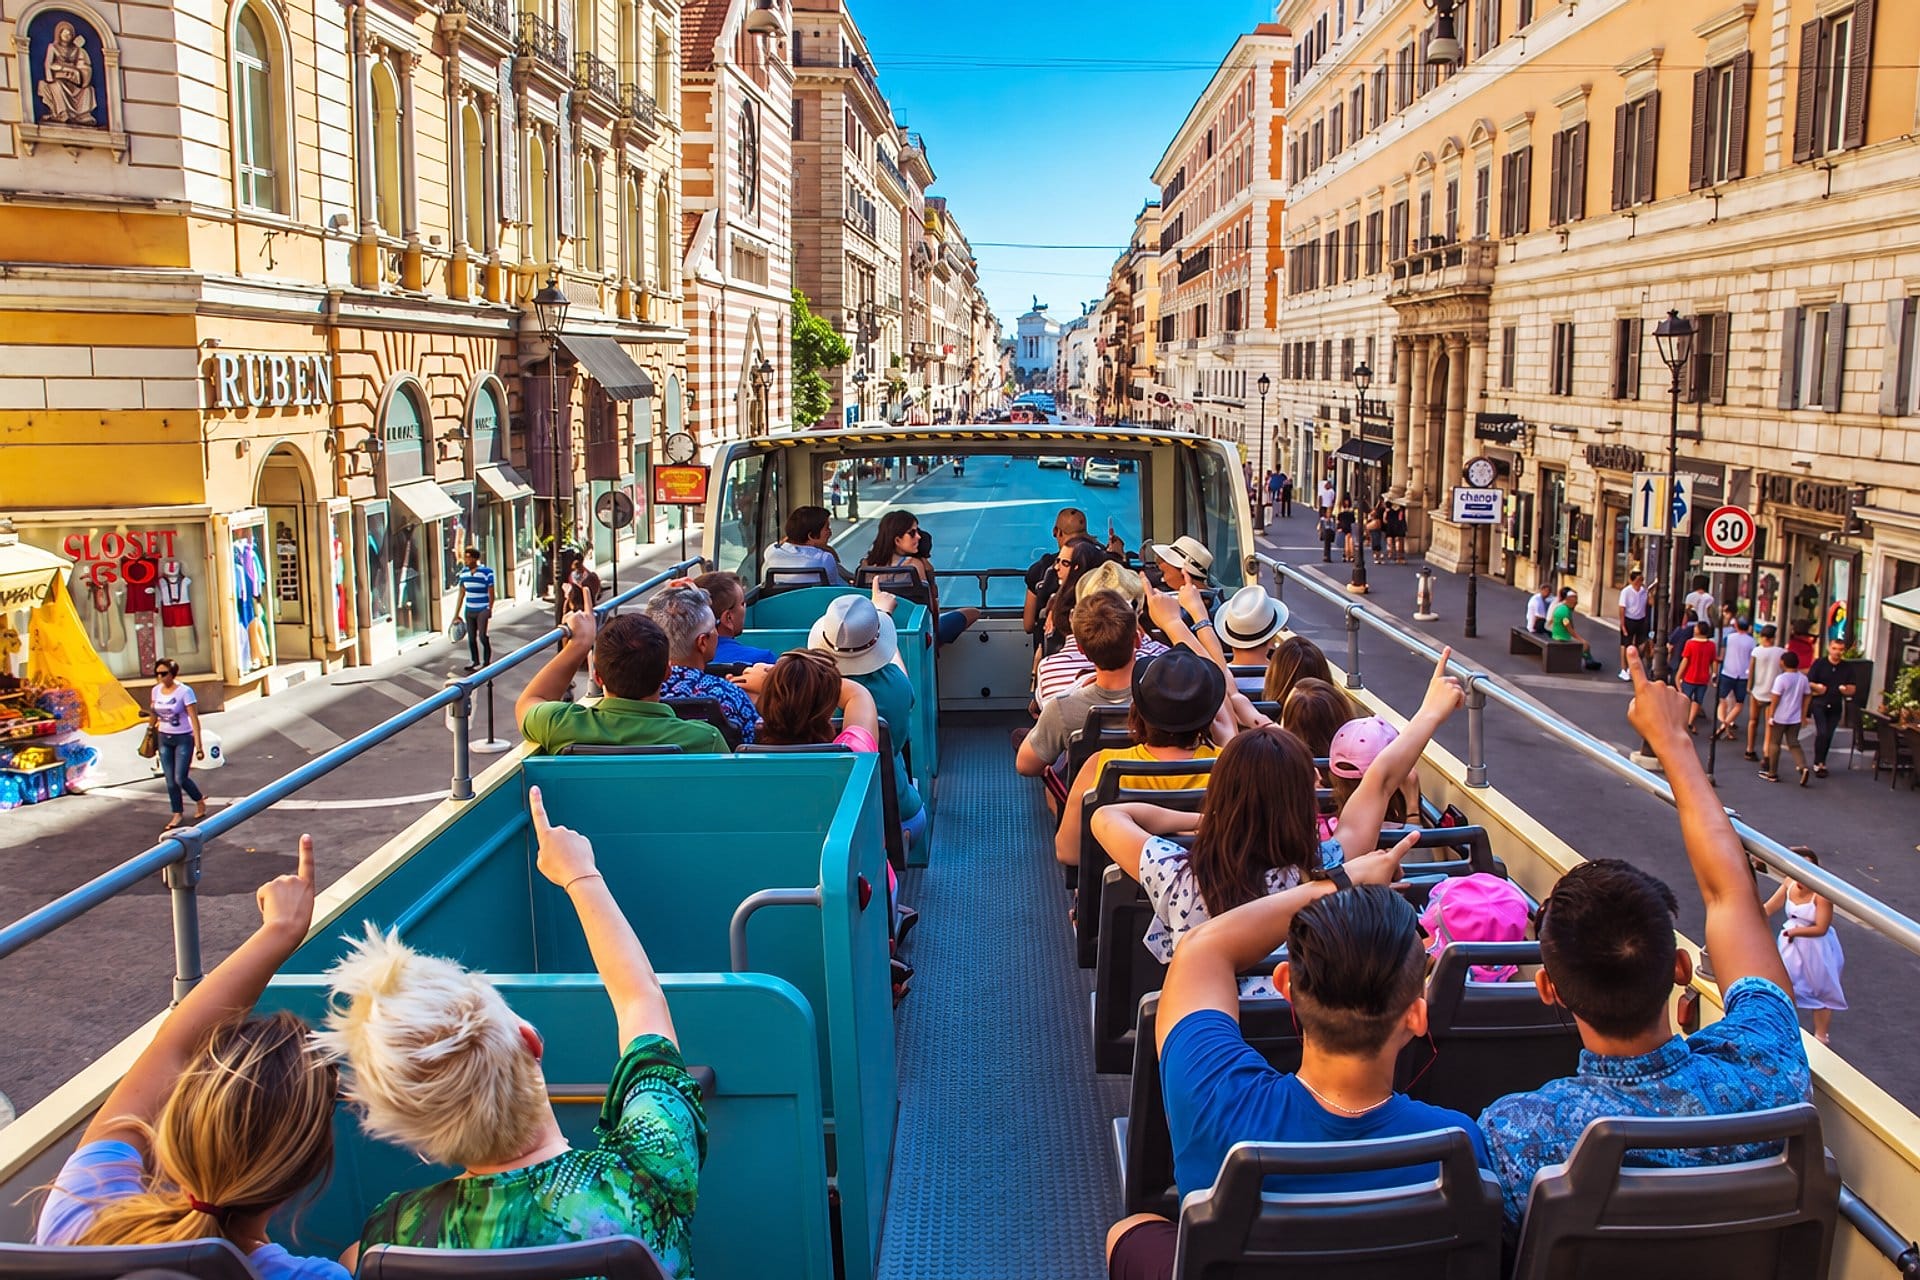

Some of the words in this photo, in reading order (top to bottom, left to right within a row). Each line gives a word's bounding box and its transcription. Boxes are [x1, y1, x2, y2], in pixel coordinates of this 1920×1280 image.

[217, 353, 332, 407] RUBEN
[64, 530, 177, 561] CLOSET
[1717, 520, 1743, 542] 30
